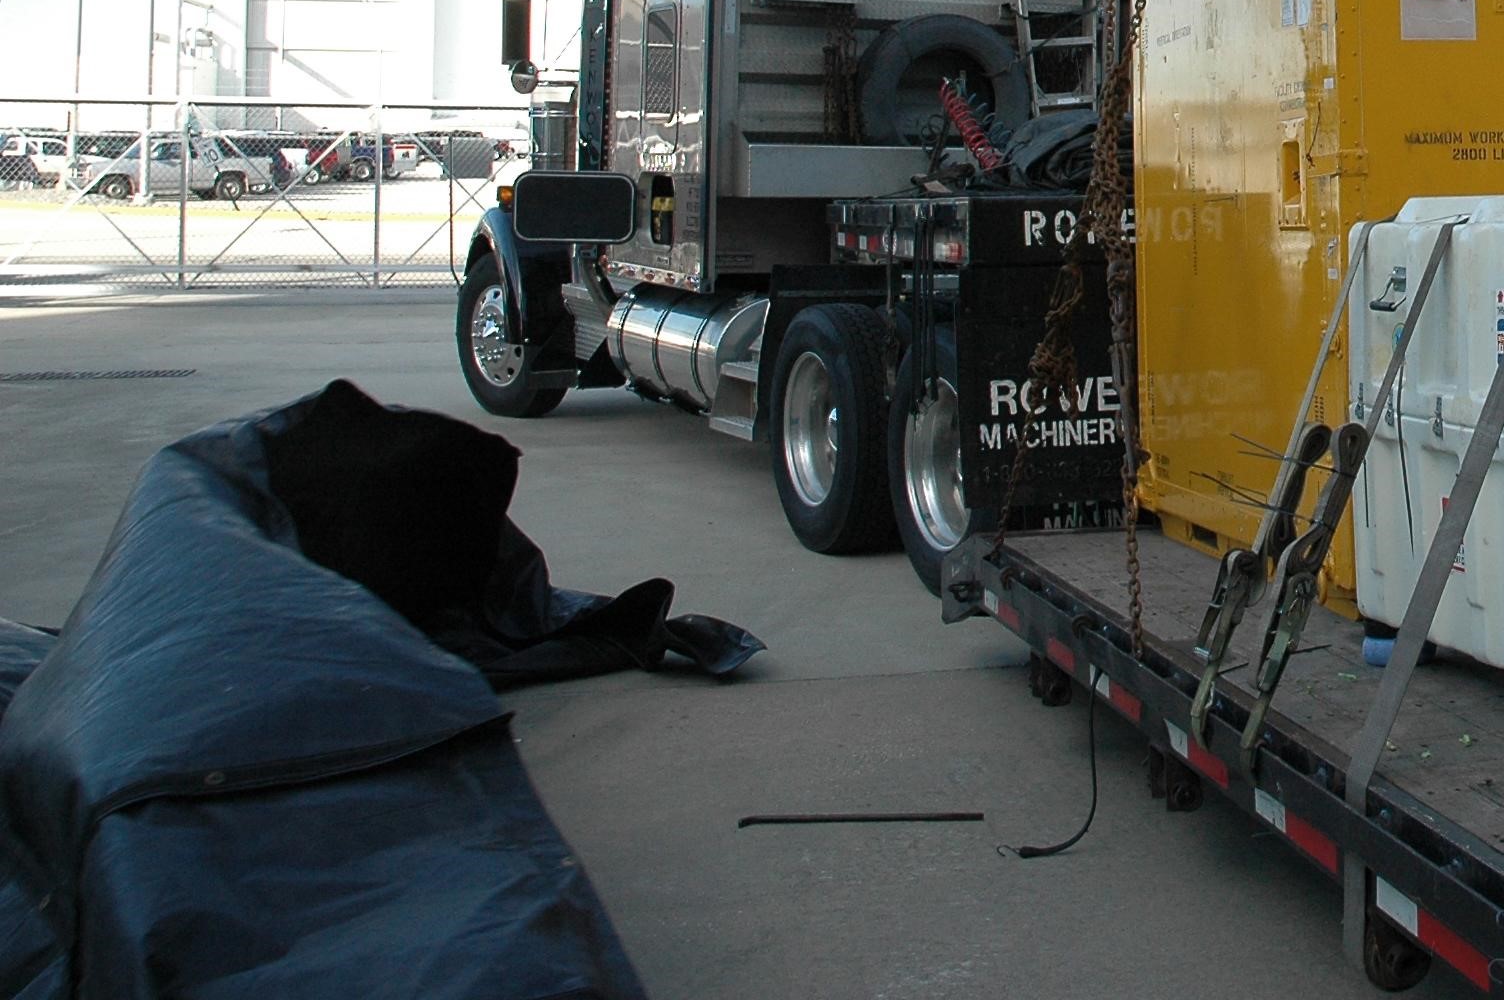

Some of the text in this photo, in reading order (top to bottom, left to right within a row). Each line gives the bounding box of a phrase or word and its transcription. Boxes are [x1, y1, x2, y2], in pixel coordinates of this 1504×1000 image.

[1405, 130, 1463, 145] MAXIMUM
[203, 148, 219, 163] 10
[1452, 147, 1487, 161] 2800
[979, 417, 1126, 451] MACHINER
